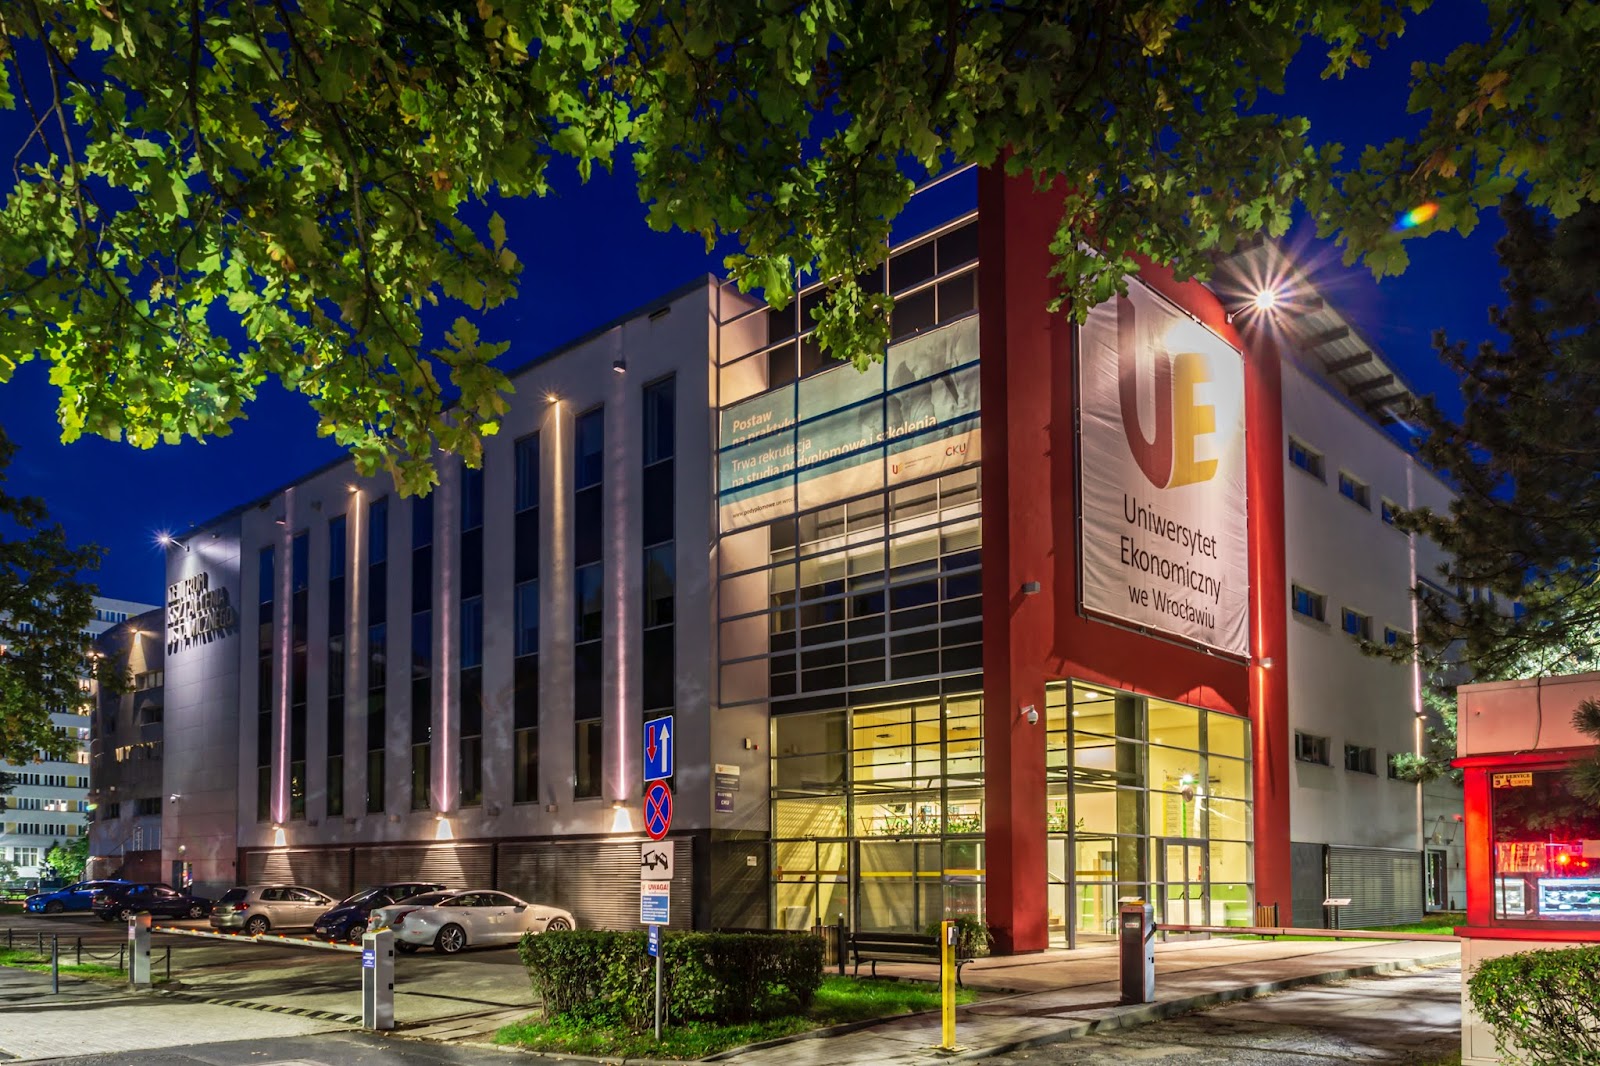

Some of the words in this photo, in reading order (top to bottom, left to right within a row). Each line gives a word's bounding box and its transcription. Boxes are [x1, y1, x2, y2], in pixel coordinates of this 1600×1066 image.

[1116, 292, 1219, 490] UE
[732, 411, 772, 433] Postaw
[732, 457, 757, 472] Trwa
[945, 443, 966, 457] CKU
[732, 478, 745, 488] na
[746, 465, 780, 484] studia
[1124, 493, 1217, 560] Uniwersytet
[1120, 535, 1221, 605] Ekonomiczny
[1128, 585, 1149, 607] we
[1152, 588, 1215, 630] Wrocławiu
